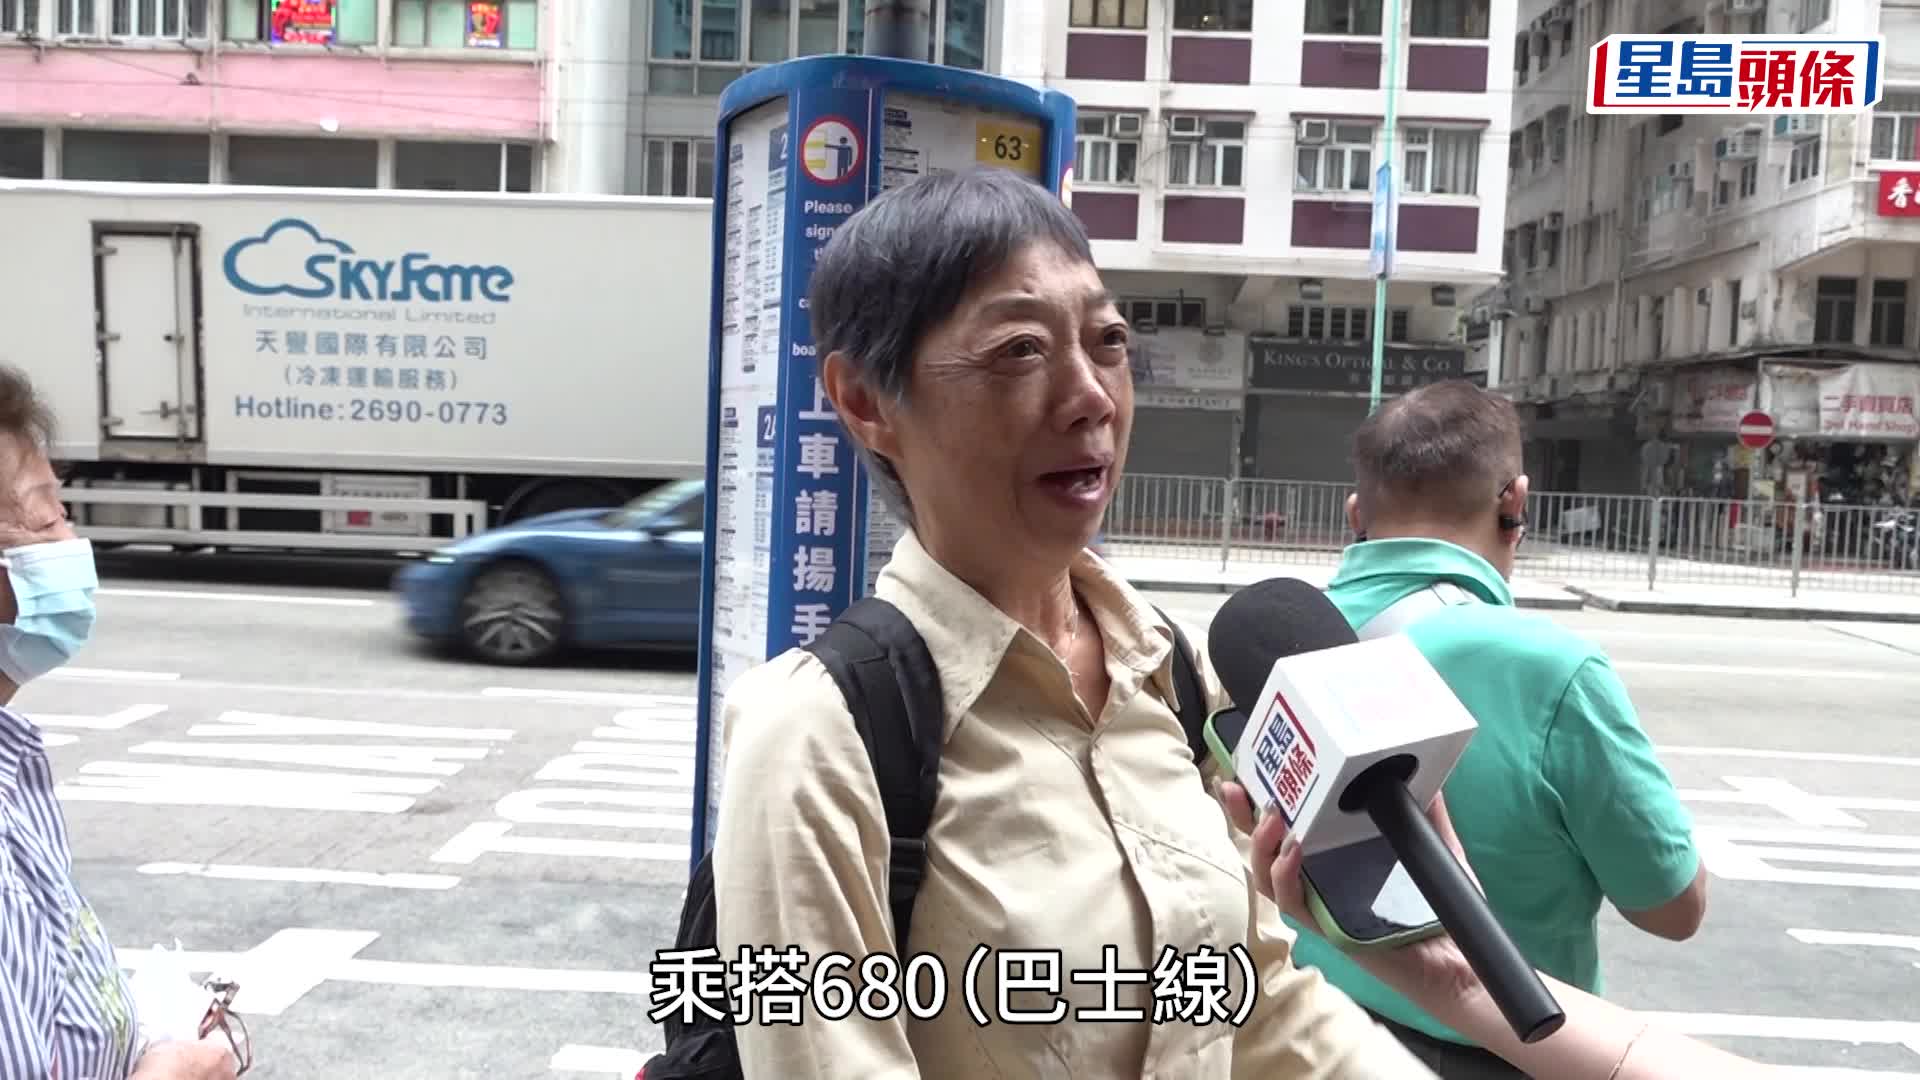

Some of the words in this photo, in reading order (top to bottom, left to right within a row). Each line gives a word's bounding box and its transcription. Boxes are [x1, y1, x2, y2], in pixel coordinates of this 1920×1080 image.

[994, 135, 1022, 161] 63
[1888, 177, 1920, 208] 香
[804, 200, 853, 214] Please
[243, 304, 396, 321] International
[405, 308, 496, 325] Limited
[790, 376, 840, 645] 上車請揚手
